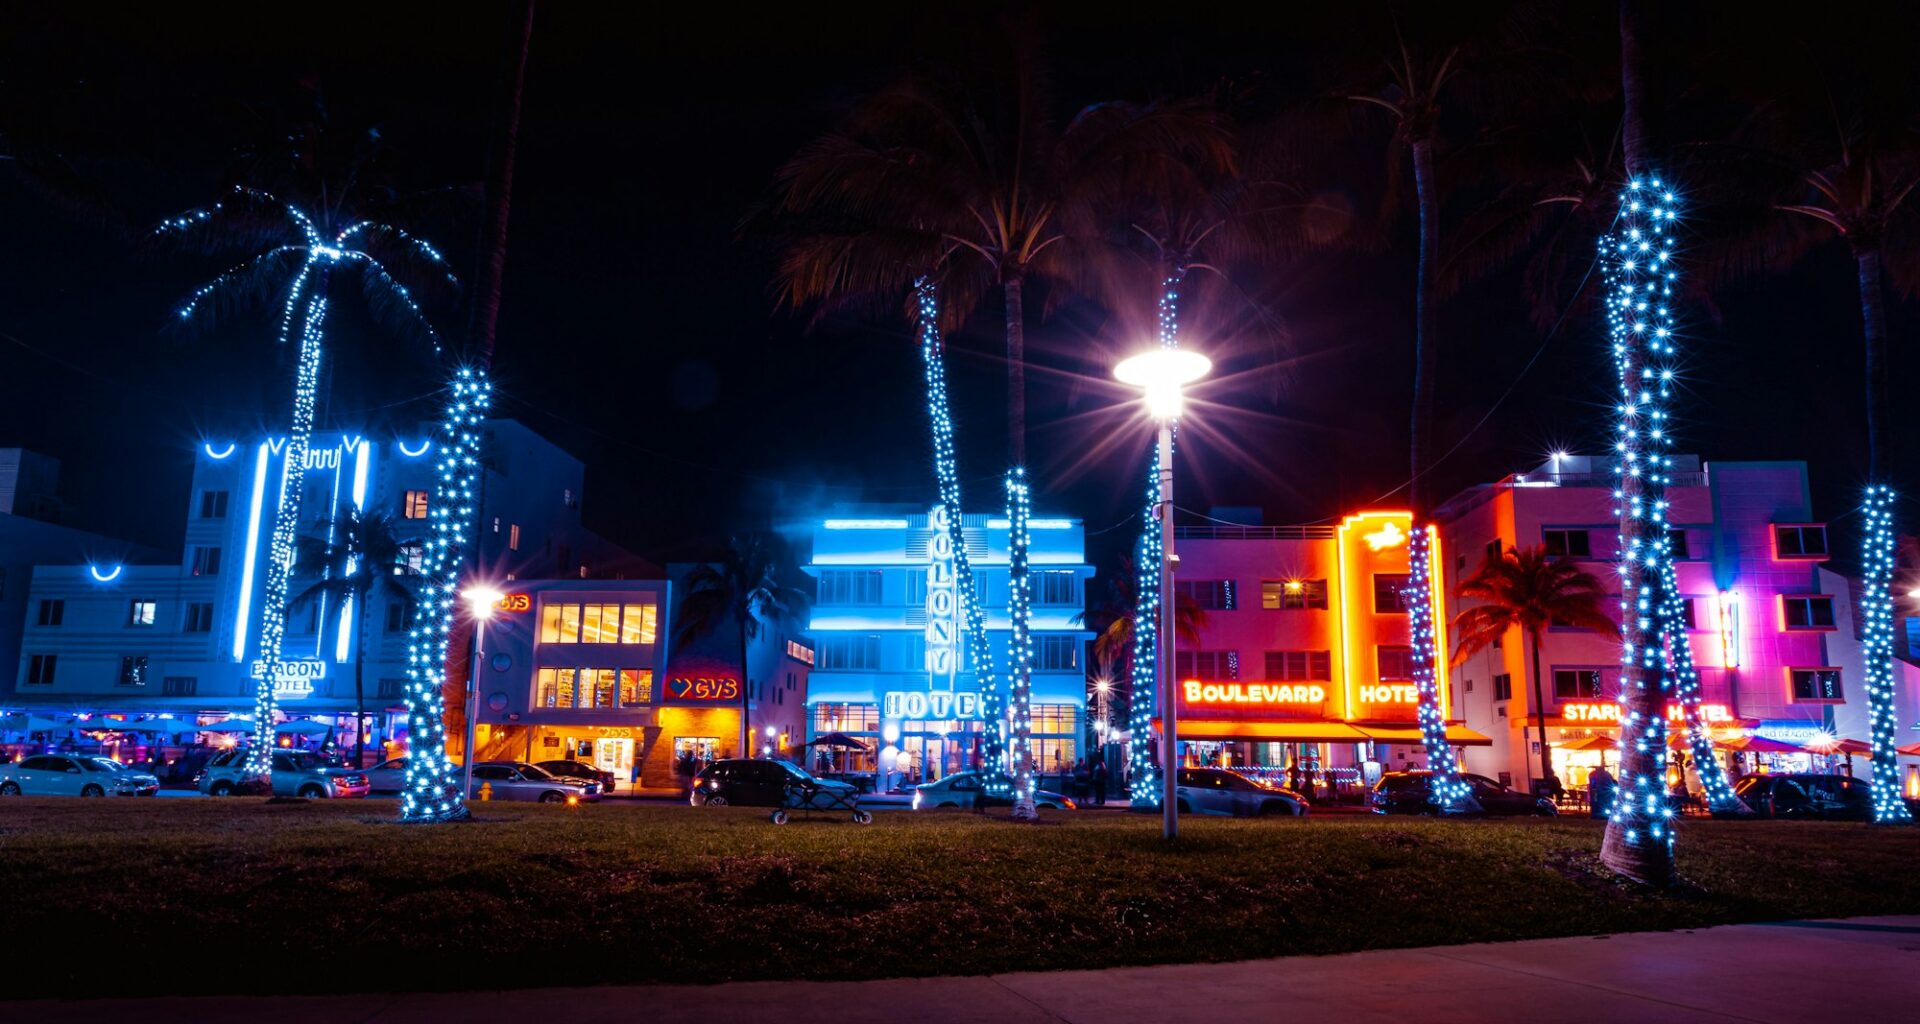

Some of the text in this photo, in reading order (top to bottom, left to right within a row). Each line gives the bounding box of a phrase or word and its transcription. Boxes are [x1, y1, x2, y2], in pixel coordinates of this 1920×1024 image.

[932, 505, 952, 675] COLONY
[250, 661, 325, 678] BACON
[274, 680, 312, 692] OTEL
[694, 677, 738, 699] CVS
[1183, 680, 1325, 703] BOULEVARD
[1359, 684, 1420, 703] HOTE
[884, 691, 985, 719] HOTE
[1563, 703, 1734, 722] STARL HTEL
[607, 728, 631, 738] CVS
